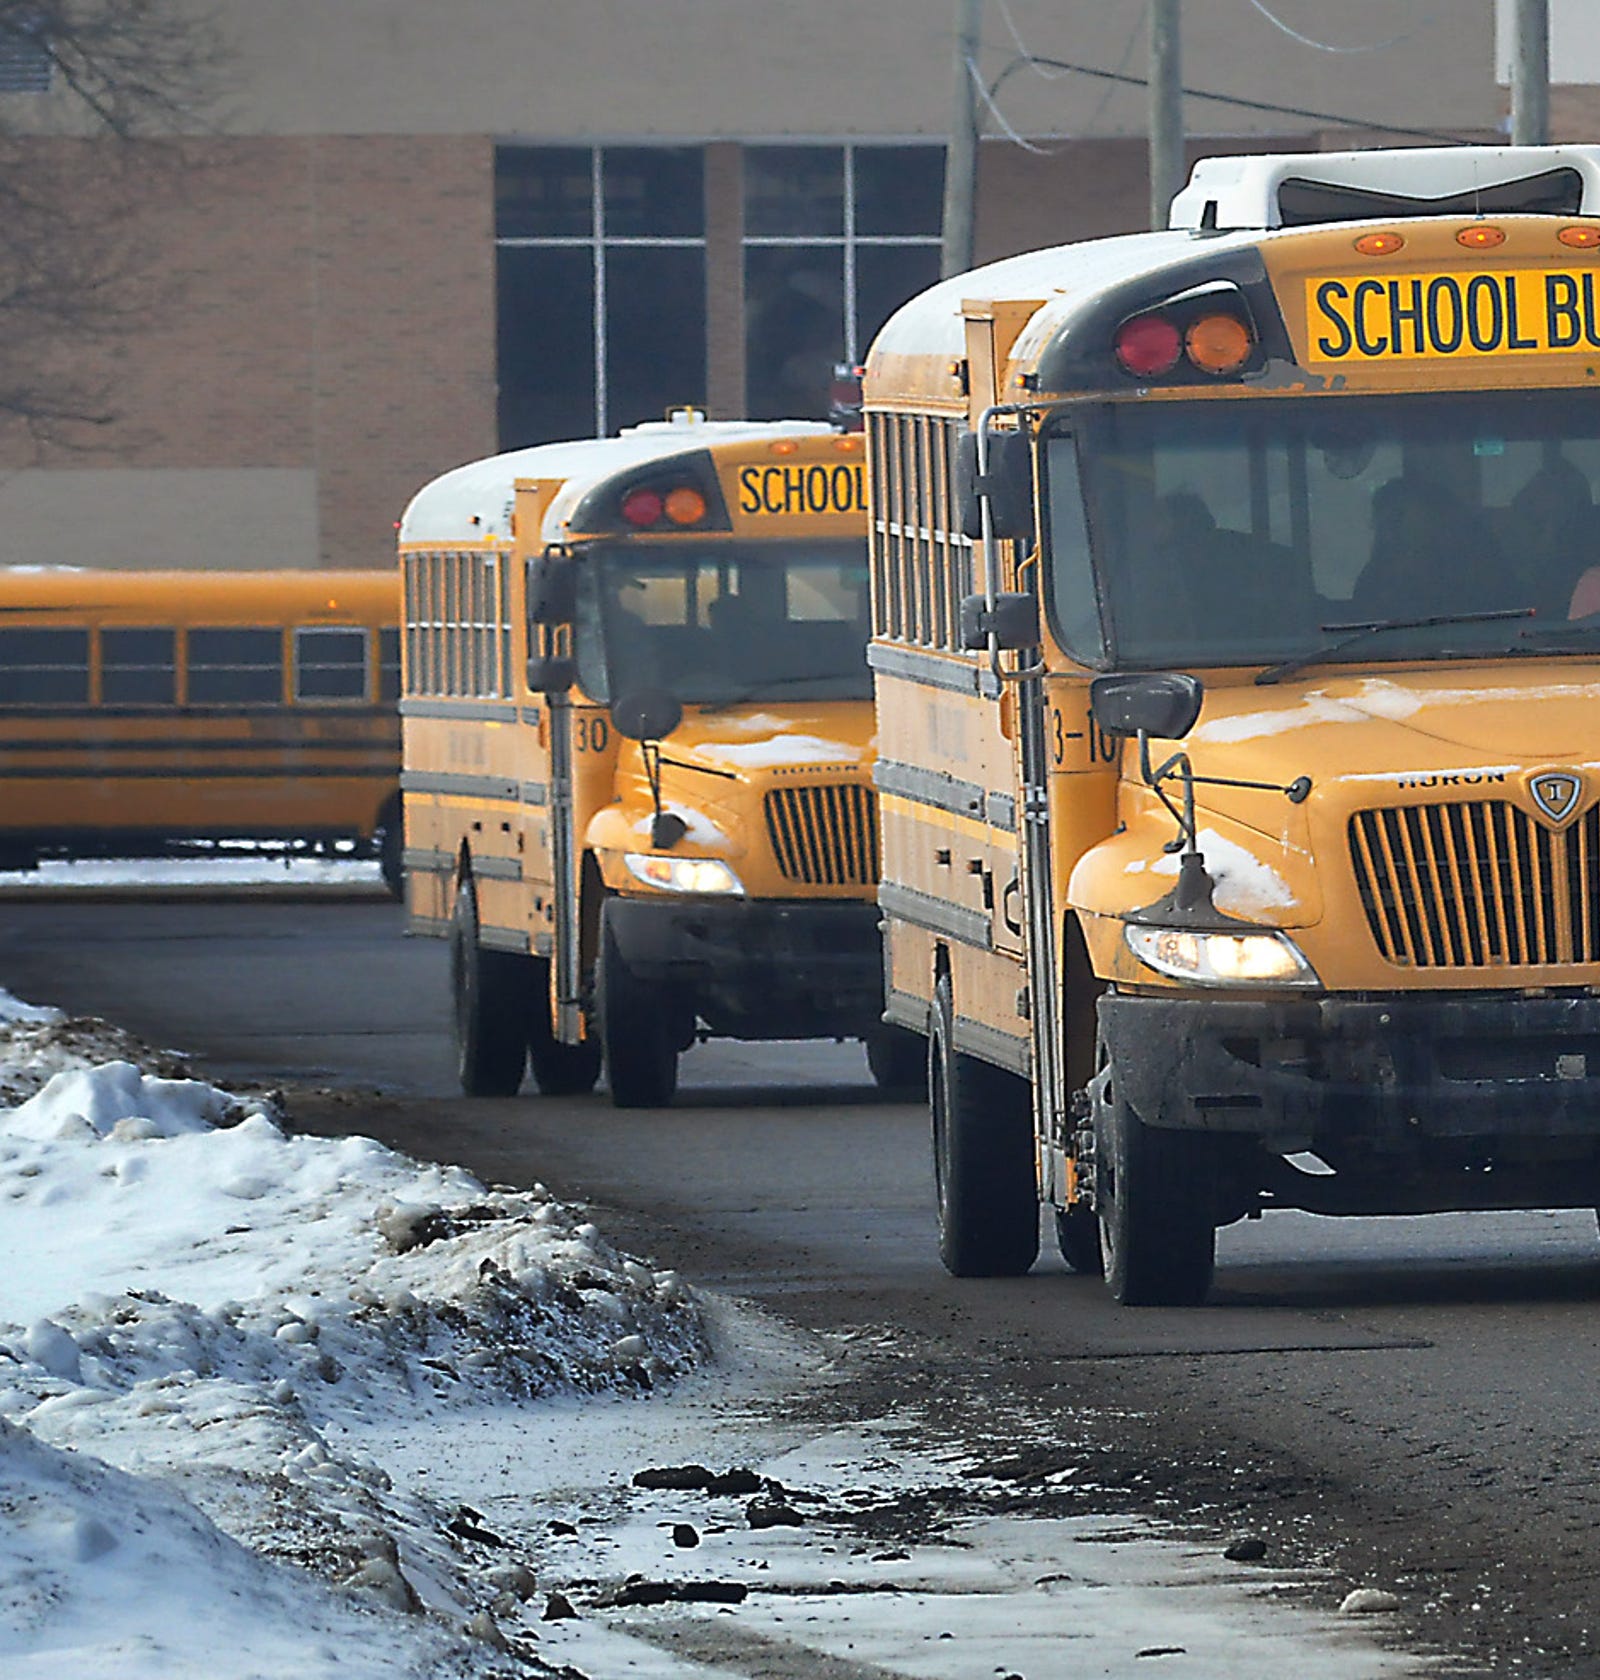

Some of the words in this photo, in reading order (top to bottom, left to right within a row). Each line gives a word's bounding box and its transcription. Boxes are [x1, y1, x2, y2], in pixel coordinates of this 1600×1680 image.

[1315, 275, 1537, 358] SCHOOL
[741, 465, 868, 513] SCHOOL
[576, 718, 607, 752] 30
